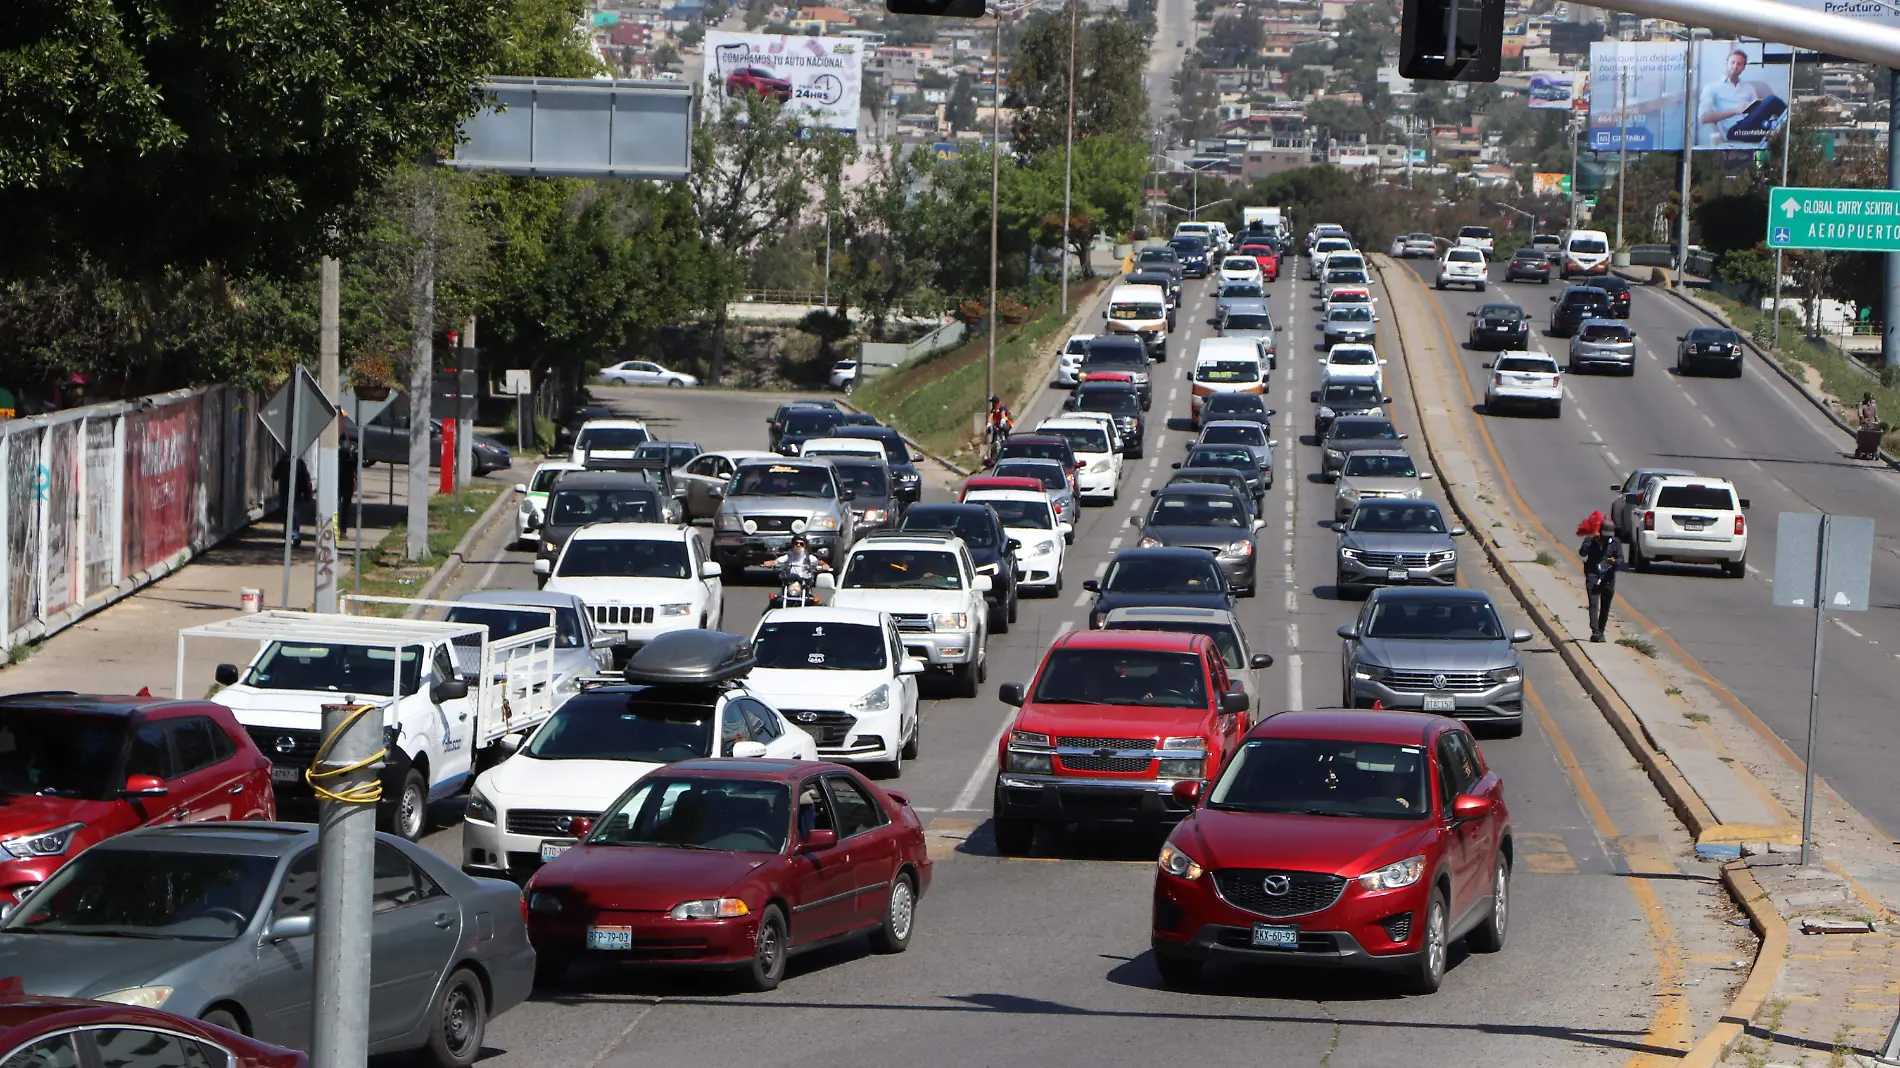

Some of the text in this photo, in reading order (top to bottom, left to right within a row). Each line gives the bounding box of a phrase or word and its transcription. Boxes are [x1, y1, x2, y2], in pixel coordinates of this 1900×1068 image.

[1824, 2, 1881, 13] Profuturo
[722, 52, 844, 69] COMPRAMOS TU AUTO NACIONAL
[795, 89, 829, 100] 24HRS
[1612, 134, 1647, 142] COTABLE
[1803, 199, 1834, 214] GLOBAL
[1837, 200, 1863, 215] ENTRY
[1864, 201, 1893, 216] SENTRI
[1807, 222, 1900, 240] AEROPUERTO
[1253, 929, 1296, 942] AKX-60-93
